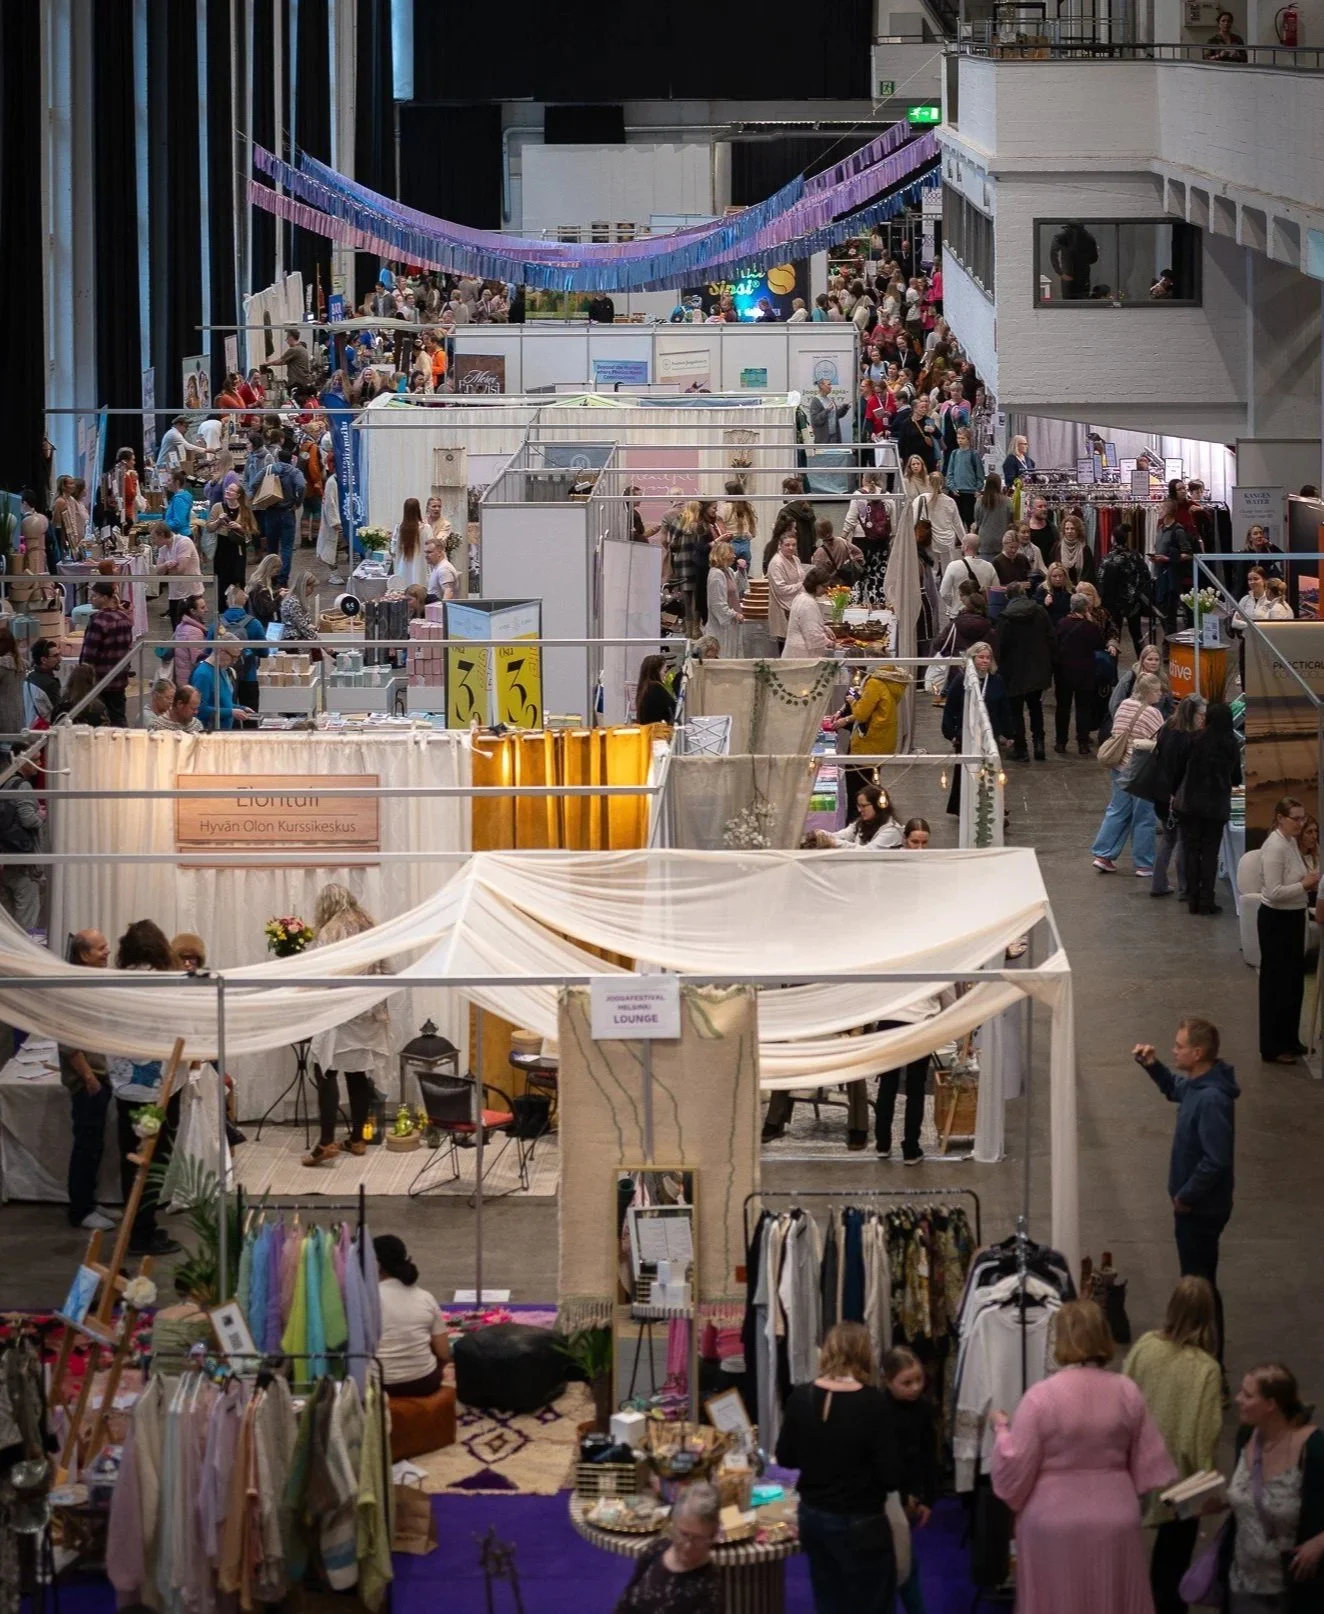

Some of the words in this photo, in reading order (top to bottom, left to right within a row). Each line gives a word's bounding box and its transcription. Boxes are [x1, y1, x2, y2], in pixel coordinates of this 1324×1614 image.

[200, 819, 240, 835] Hyvän
[243, 819, 273, 833] Olon
[278, 819, 357, 833] Kurssikeskus
[617, 1003, 652, 1011] HELSINKI
[613, 1014, 659, 1024] LOUNGE
